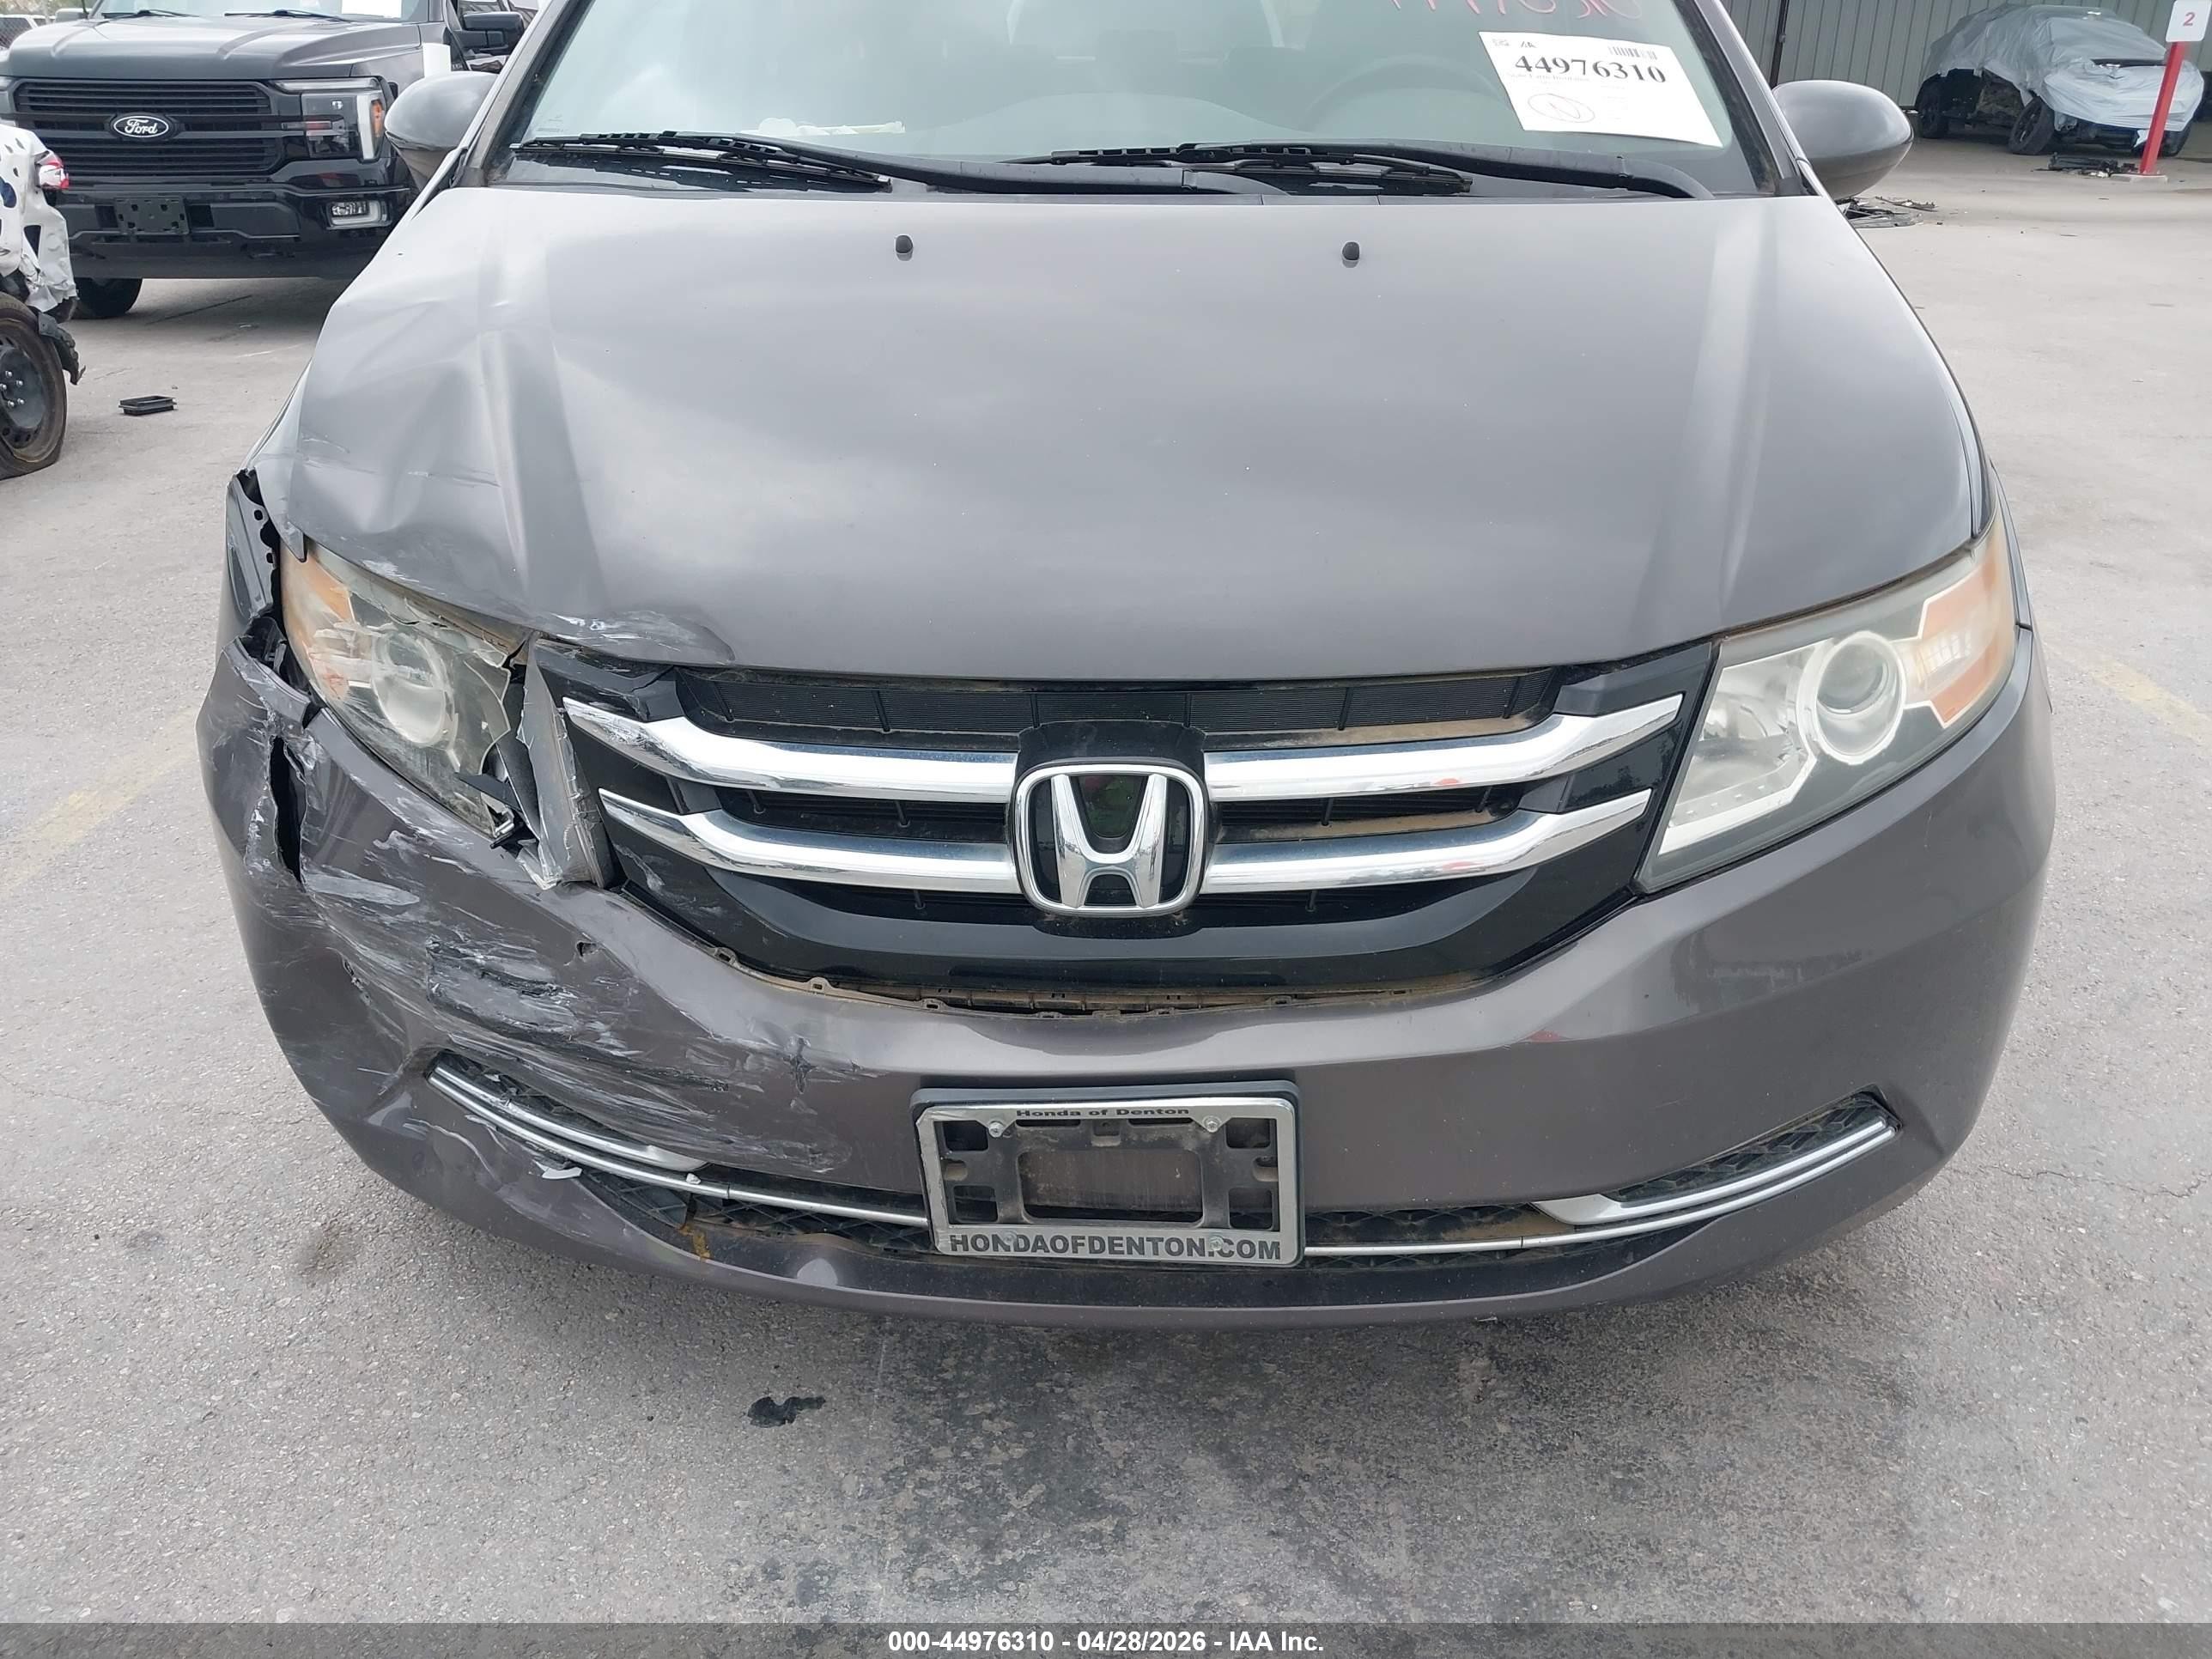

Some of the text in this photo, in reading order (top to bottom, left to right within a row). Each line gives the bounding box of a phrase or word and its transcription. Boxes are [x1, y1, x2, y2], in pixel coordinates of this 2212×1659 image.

[2183, 12, 2196, 27] 2
[1515, 55, 1666, 83] 44976310
[125, 118, 158, 134] Ford
[950, 1234, 1281, 1261] HONDAOFDENTON.COM
